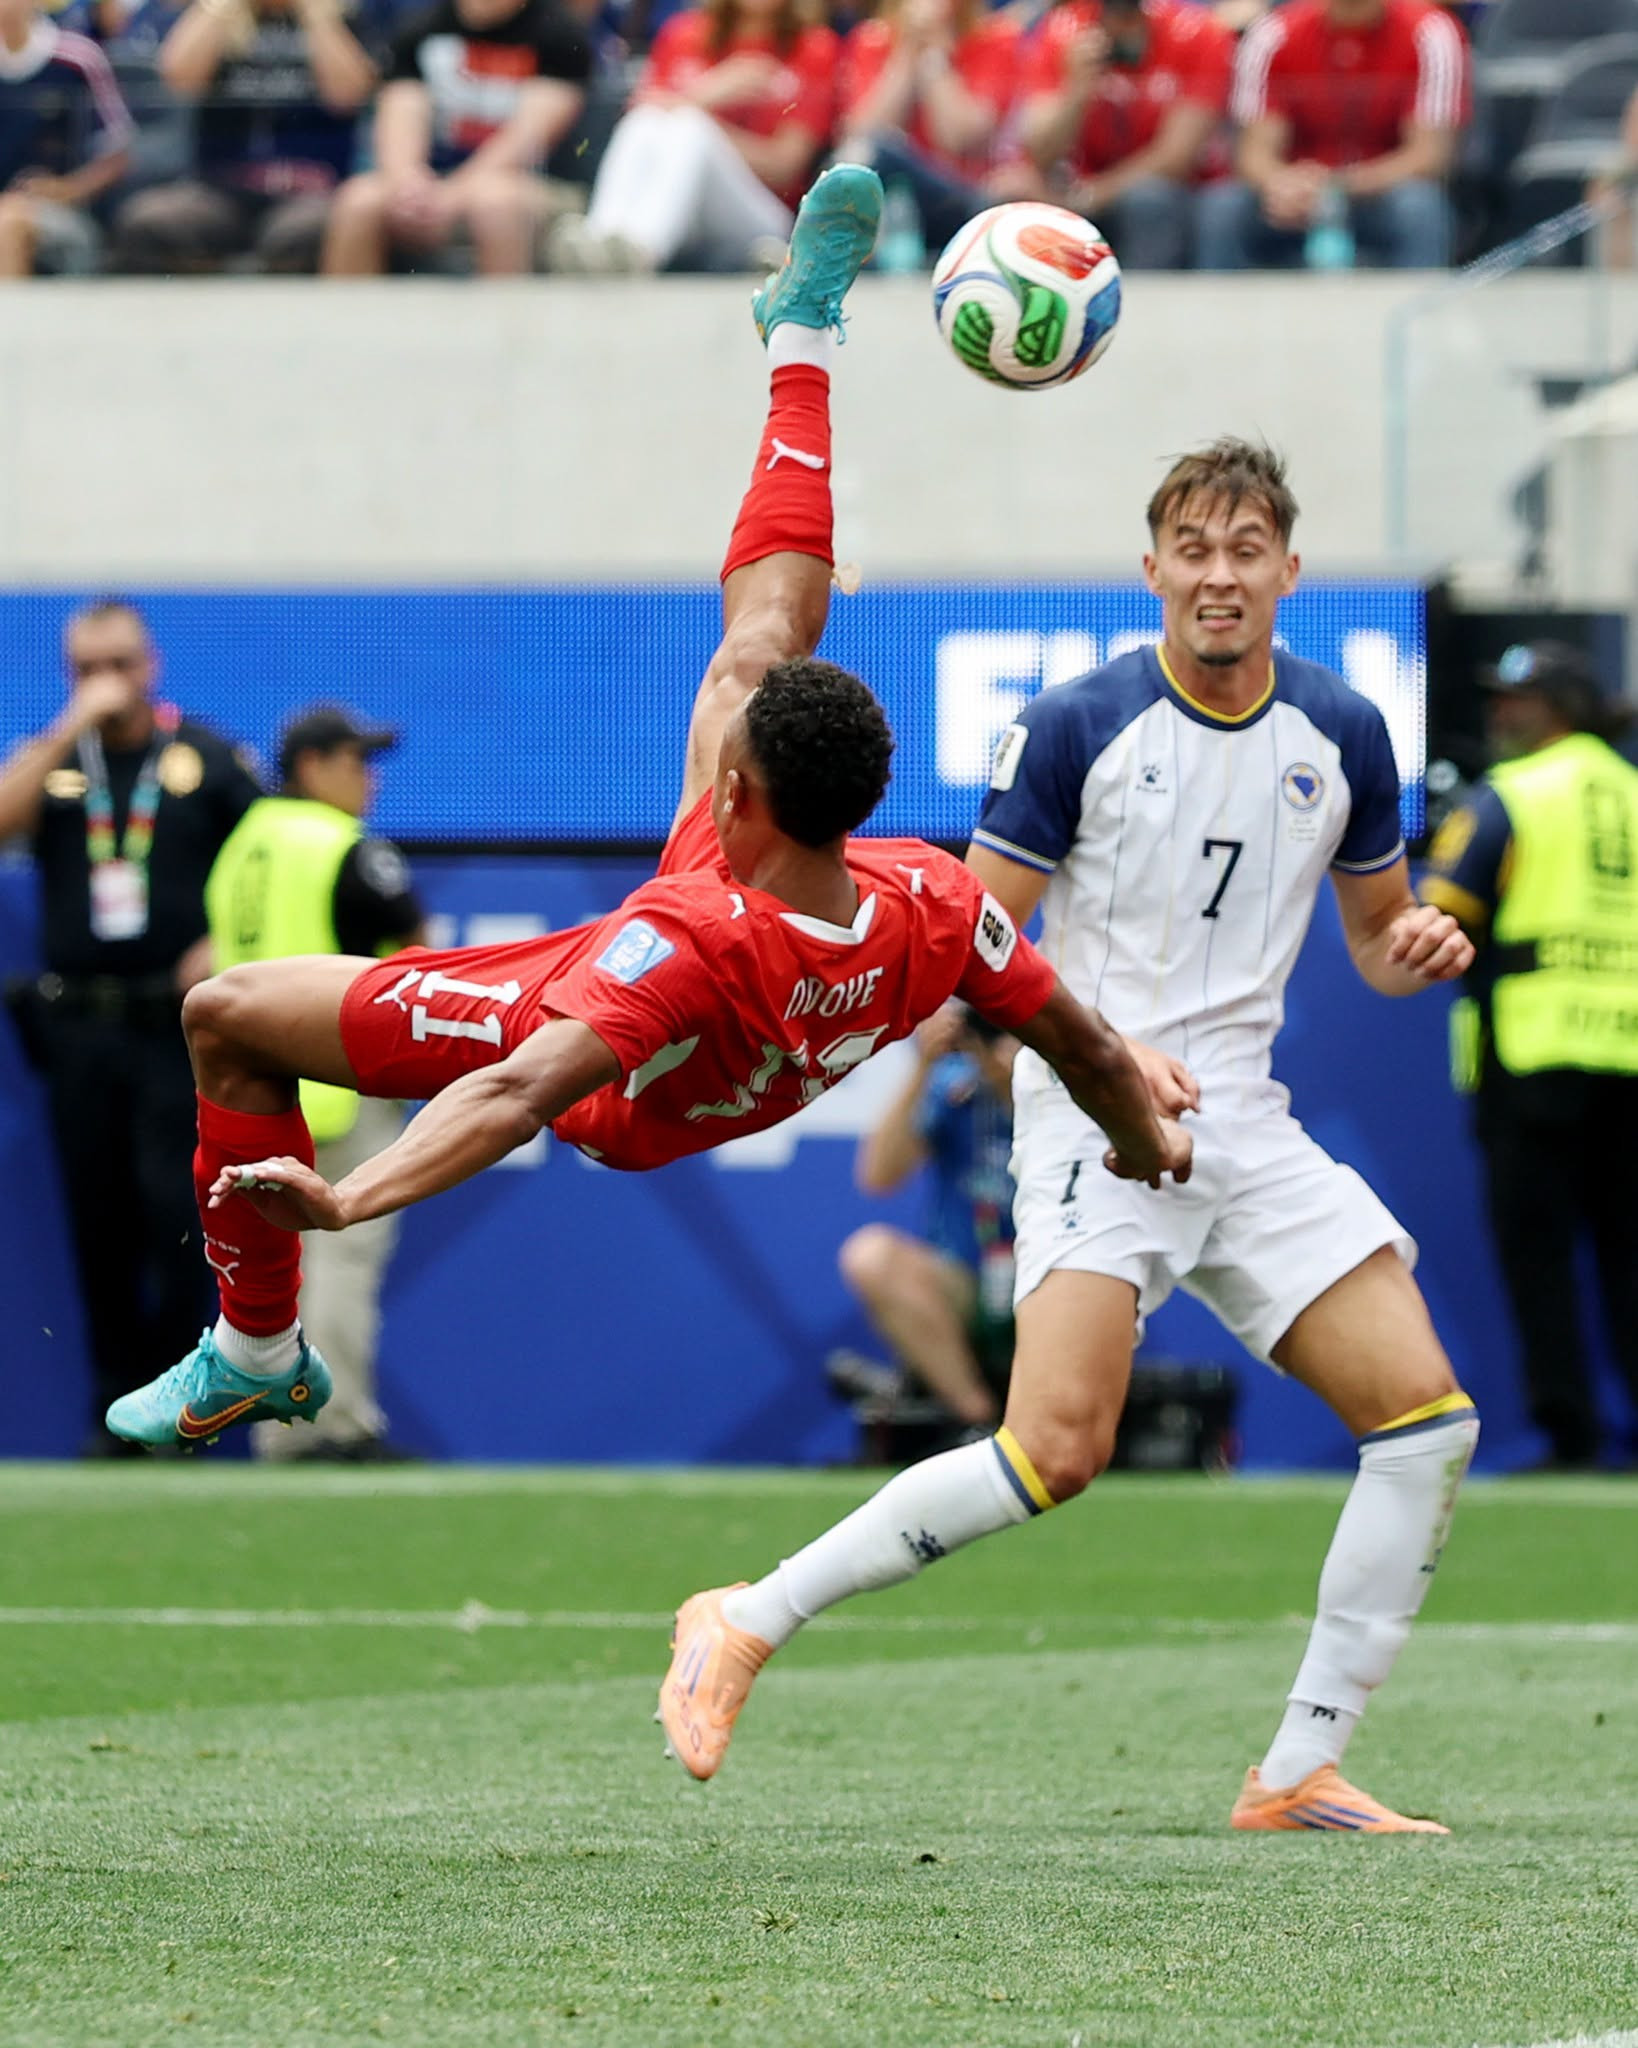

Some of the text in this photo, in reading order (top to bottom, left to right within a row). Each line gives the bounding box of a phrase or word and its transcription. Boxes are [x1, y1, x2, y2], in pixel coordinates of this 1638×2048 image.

[1202, 838, 1243, 918] 7
[411, 970, 522, 1048] 11
[783, 966, 884, 1021] NDOYE
